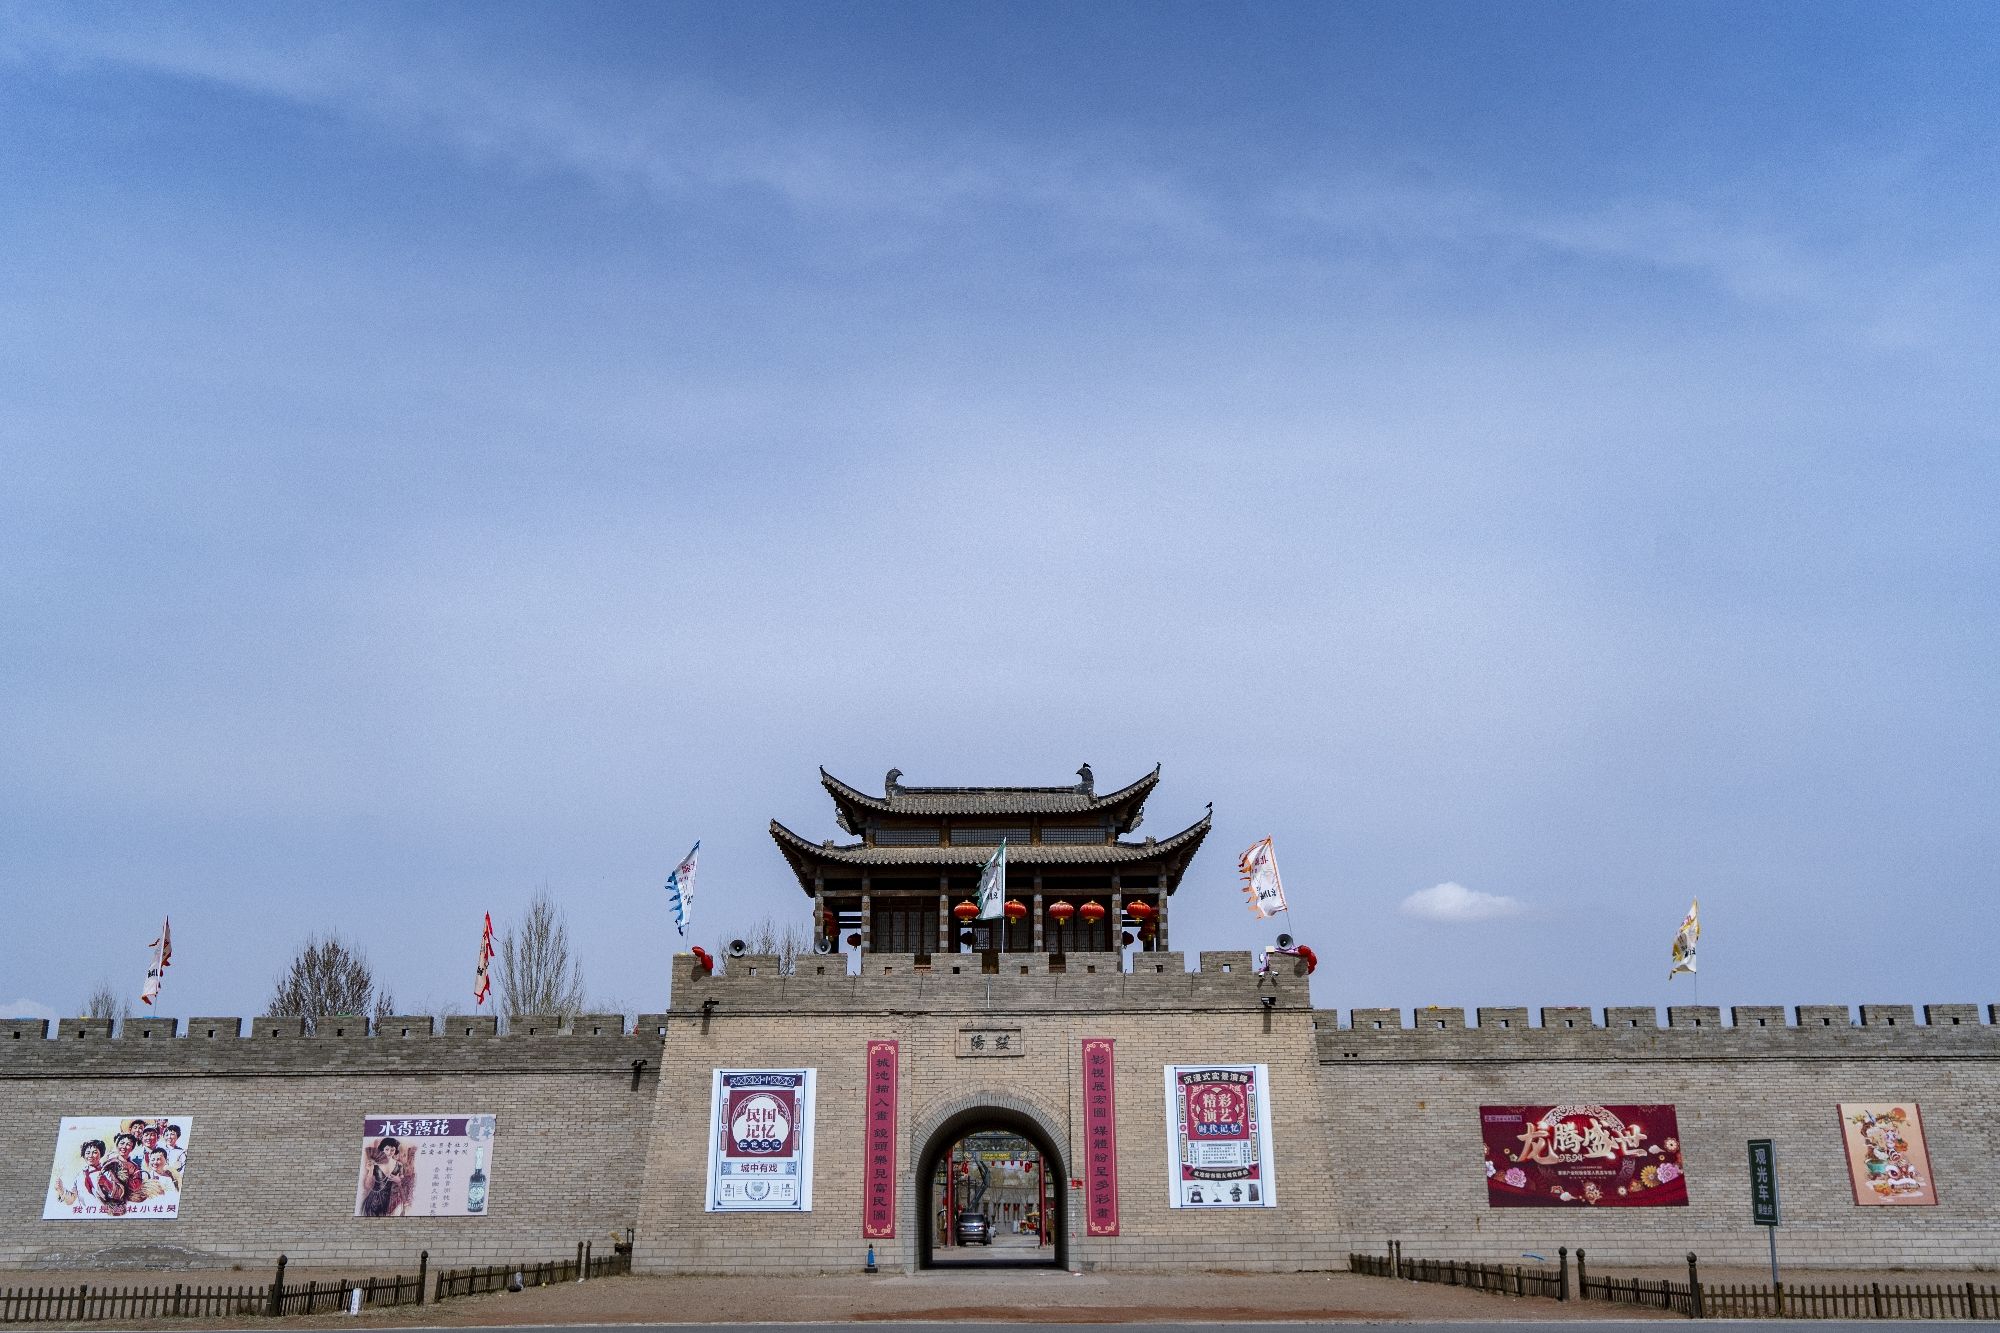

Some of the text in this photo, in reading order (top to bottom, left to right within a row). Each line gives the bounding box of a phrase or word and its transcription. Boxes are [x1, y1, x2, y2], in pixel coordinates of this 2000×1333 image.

[1202, 1093, 1232, 1108] 精彩
[745, 1108, 777, 1123] 民国
[1203, 1108, 1233, 1122] 演艺
[745, 1123, 776, 1138] 记忆
[1198, 1123, 1240, 1133] 时代记忆
[1516, 1117, 1648, 1165] 龙腾盛世
[740, 1163, 778, 1173] 城中有戏
[1754, 1148, 1770, 1201] 观光车
